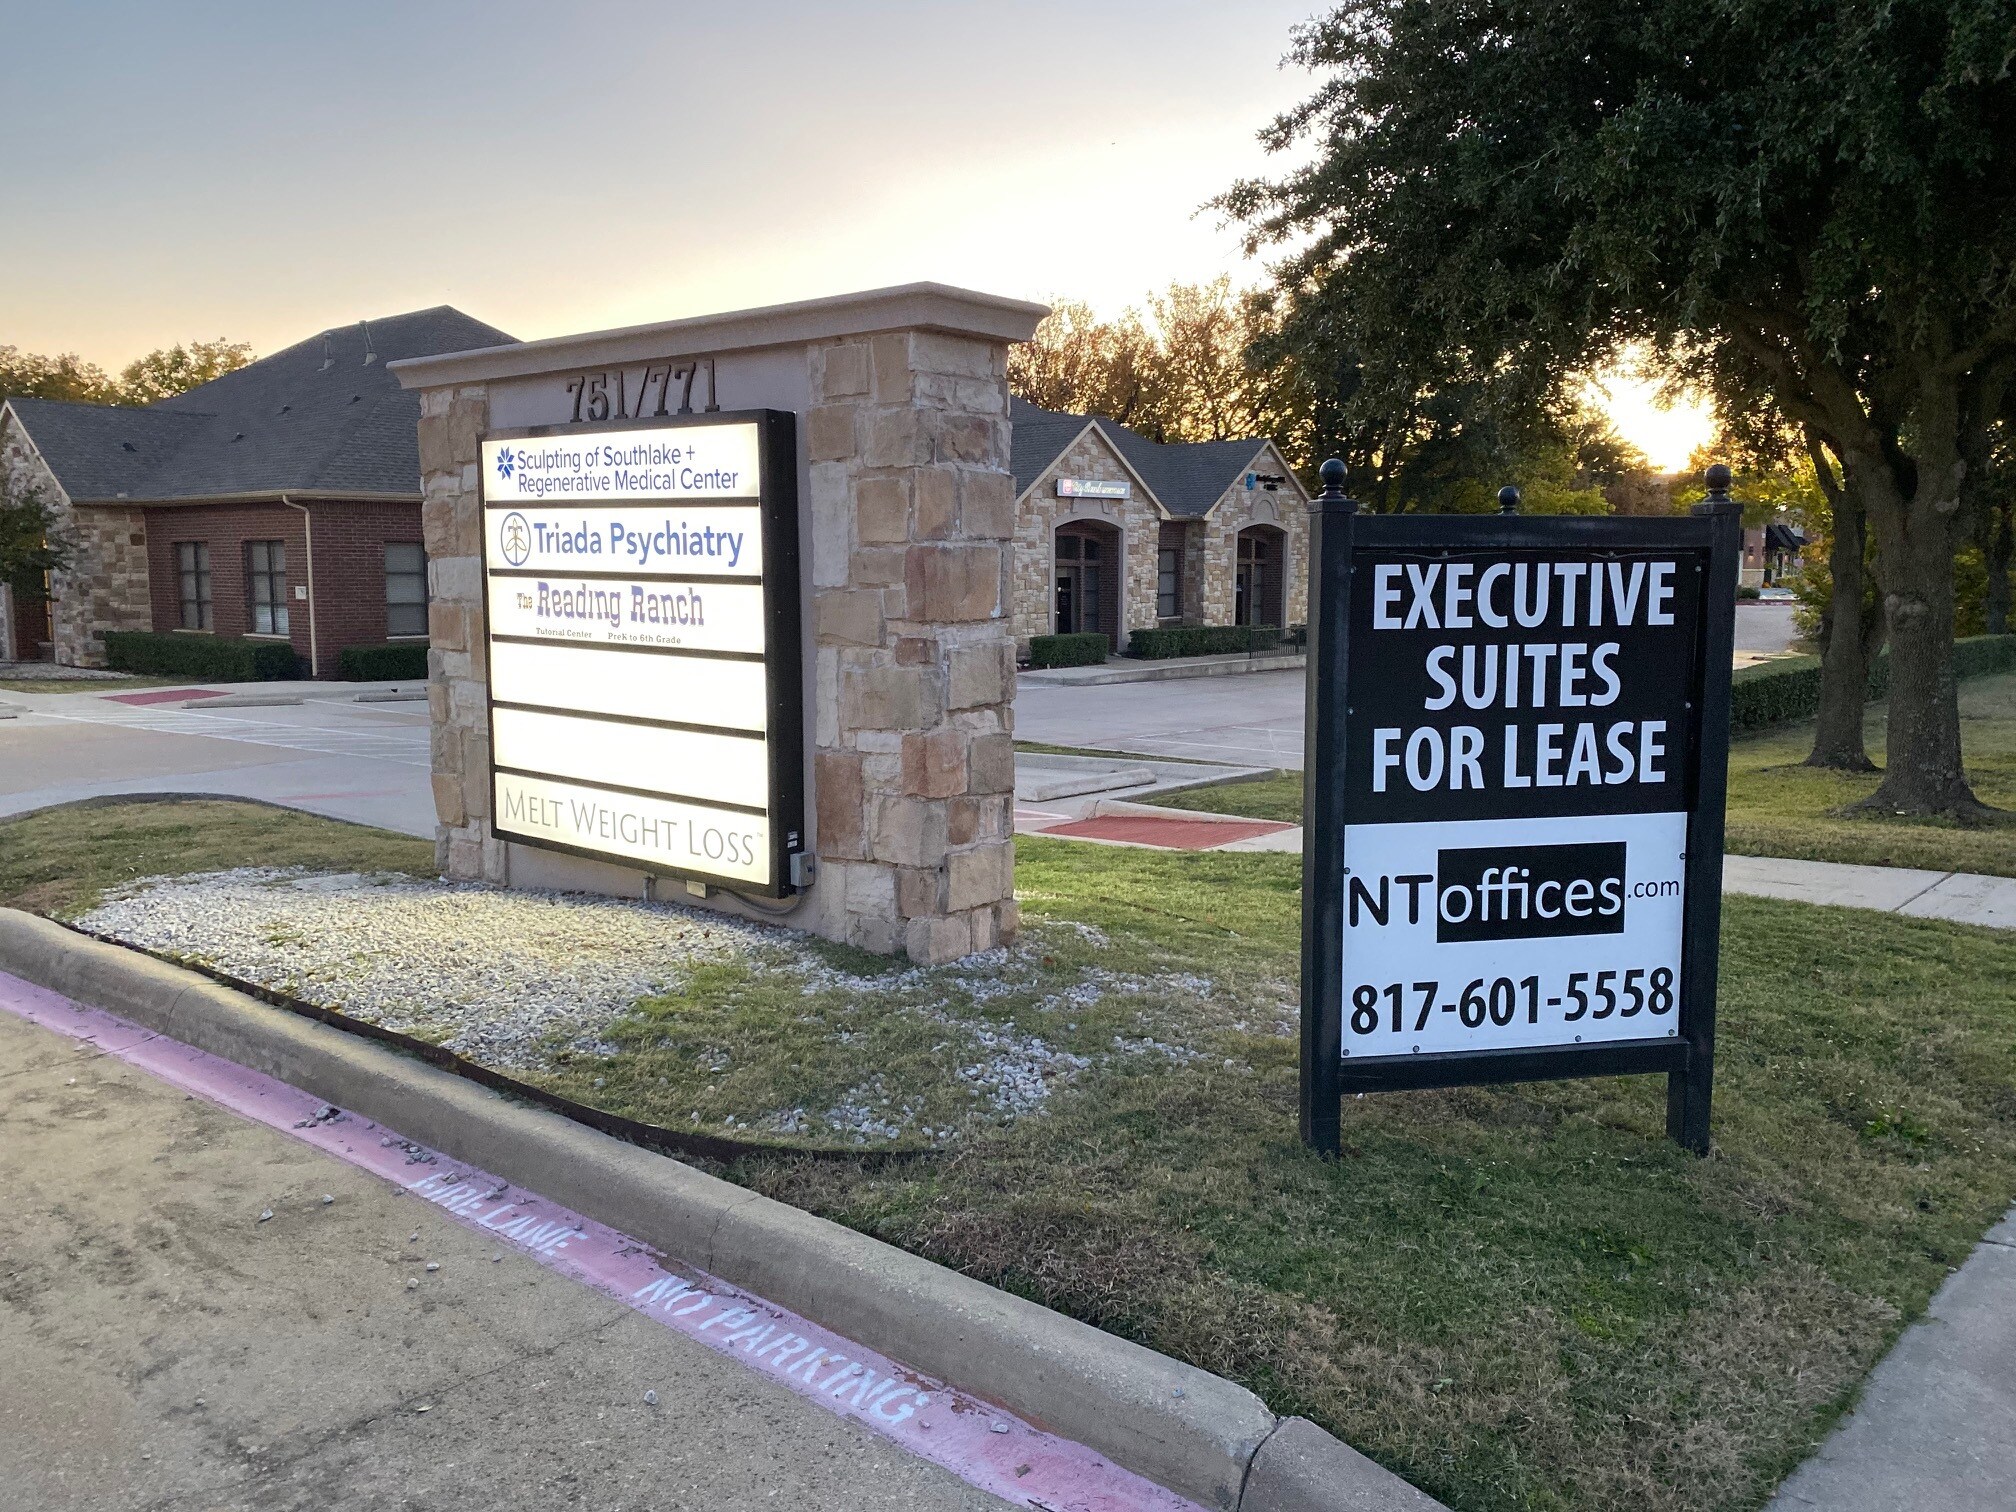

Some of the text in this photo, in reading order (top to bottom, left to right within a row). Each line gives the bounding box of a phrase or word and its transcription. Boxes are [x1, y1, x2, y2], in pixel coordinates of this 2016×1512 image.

[566, 358, 720, 422] 751/771
[517, 450, 581, 473] Sculpting
[585, 447, 600, 467] of
[603, 443, 681, 466] Southlake
[518, 467, 738, 497] Regenerative Medical Center
[533, 520, 743, 567] Triada Psychiatry
[517, 581, 704, 628] The Reading Ranch
[1373, 562, 1676, 630] EXECUTIVE
[536, 627, 592, 638] Tutorial Center
[608, 632, 681, 644] PreK to 6th Grade
[1424, 642, 1621, 711] SUITES
[1373, 720, 1667, 792] FOR LEASE
[505, 787, 563, 829] MELT
[571, 799, 677, 851] WEIGHT
[1350, 967, 1674, 1035] 817-601-5558
[476, 1203, 589, 1256] LANE
[632, 1275, 930, 1425] NO PARKING
